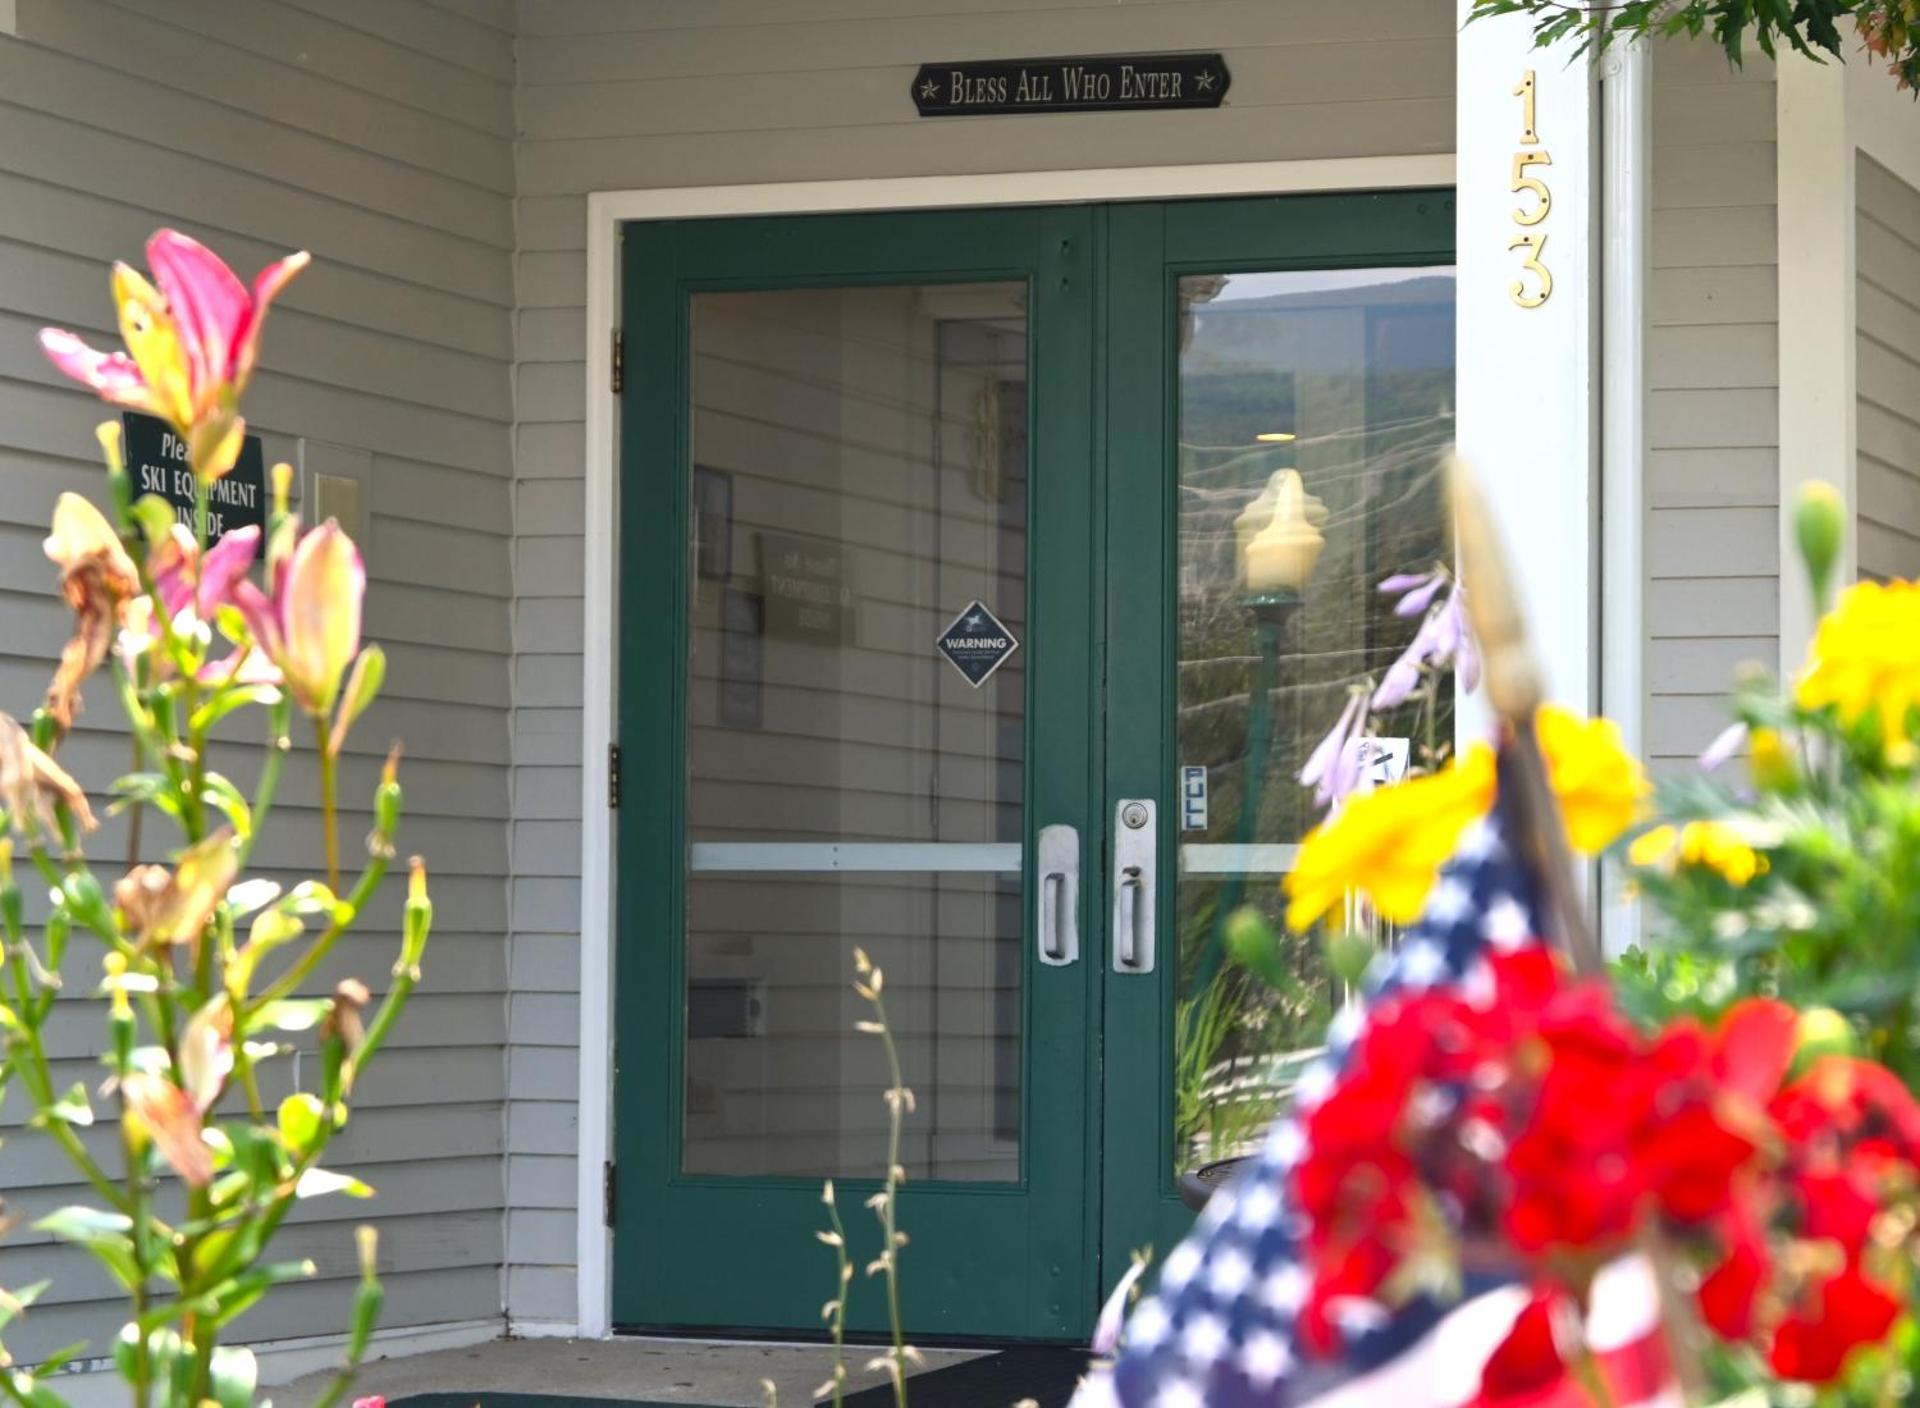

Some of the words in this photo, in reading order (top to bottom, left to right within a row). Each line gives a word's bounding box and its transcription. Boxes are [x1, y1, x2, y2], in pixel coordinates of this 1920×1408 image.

[1508, 69, 1553, 309] 153
[162, 432, 194, 462] Plea
[141, 464, 167, 492] SKI
[177, 506, 224, 537] INSDE
[945, 638, 1007, 649] WARNING
[1185, 767, 1204, 828] PULL
